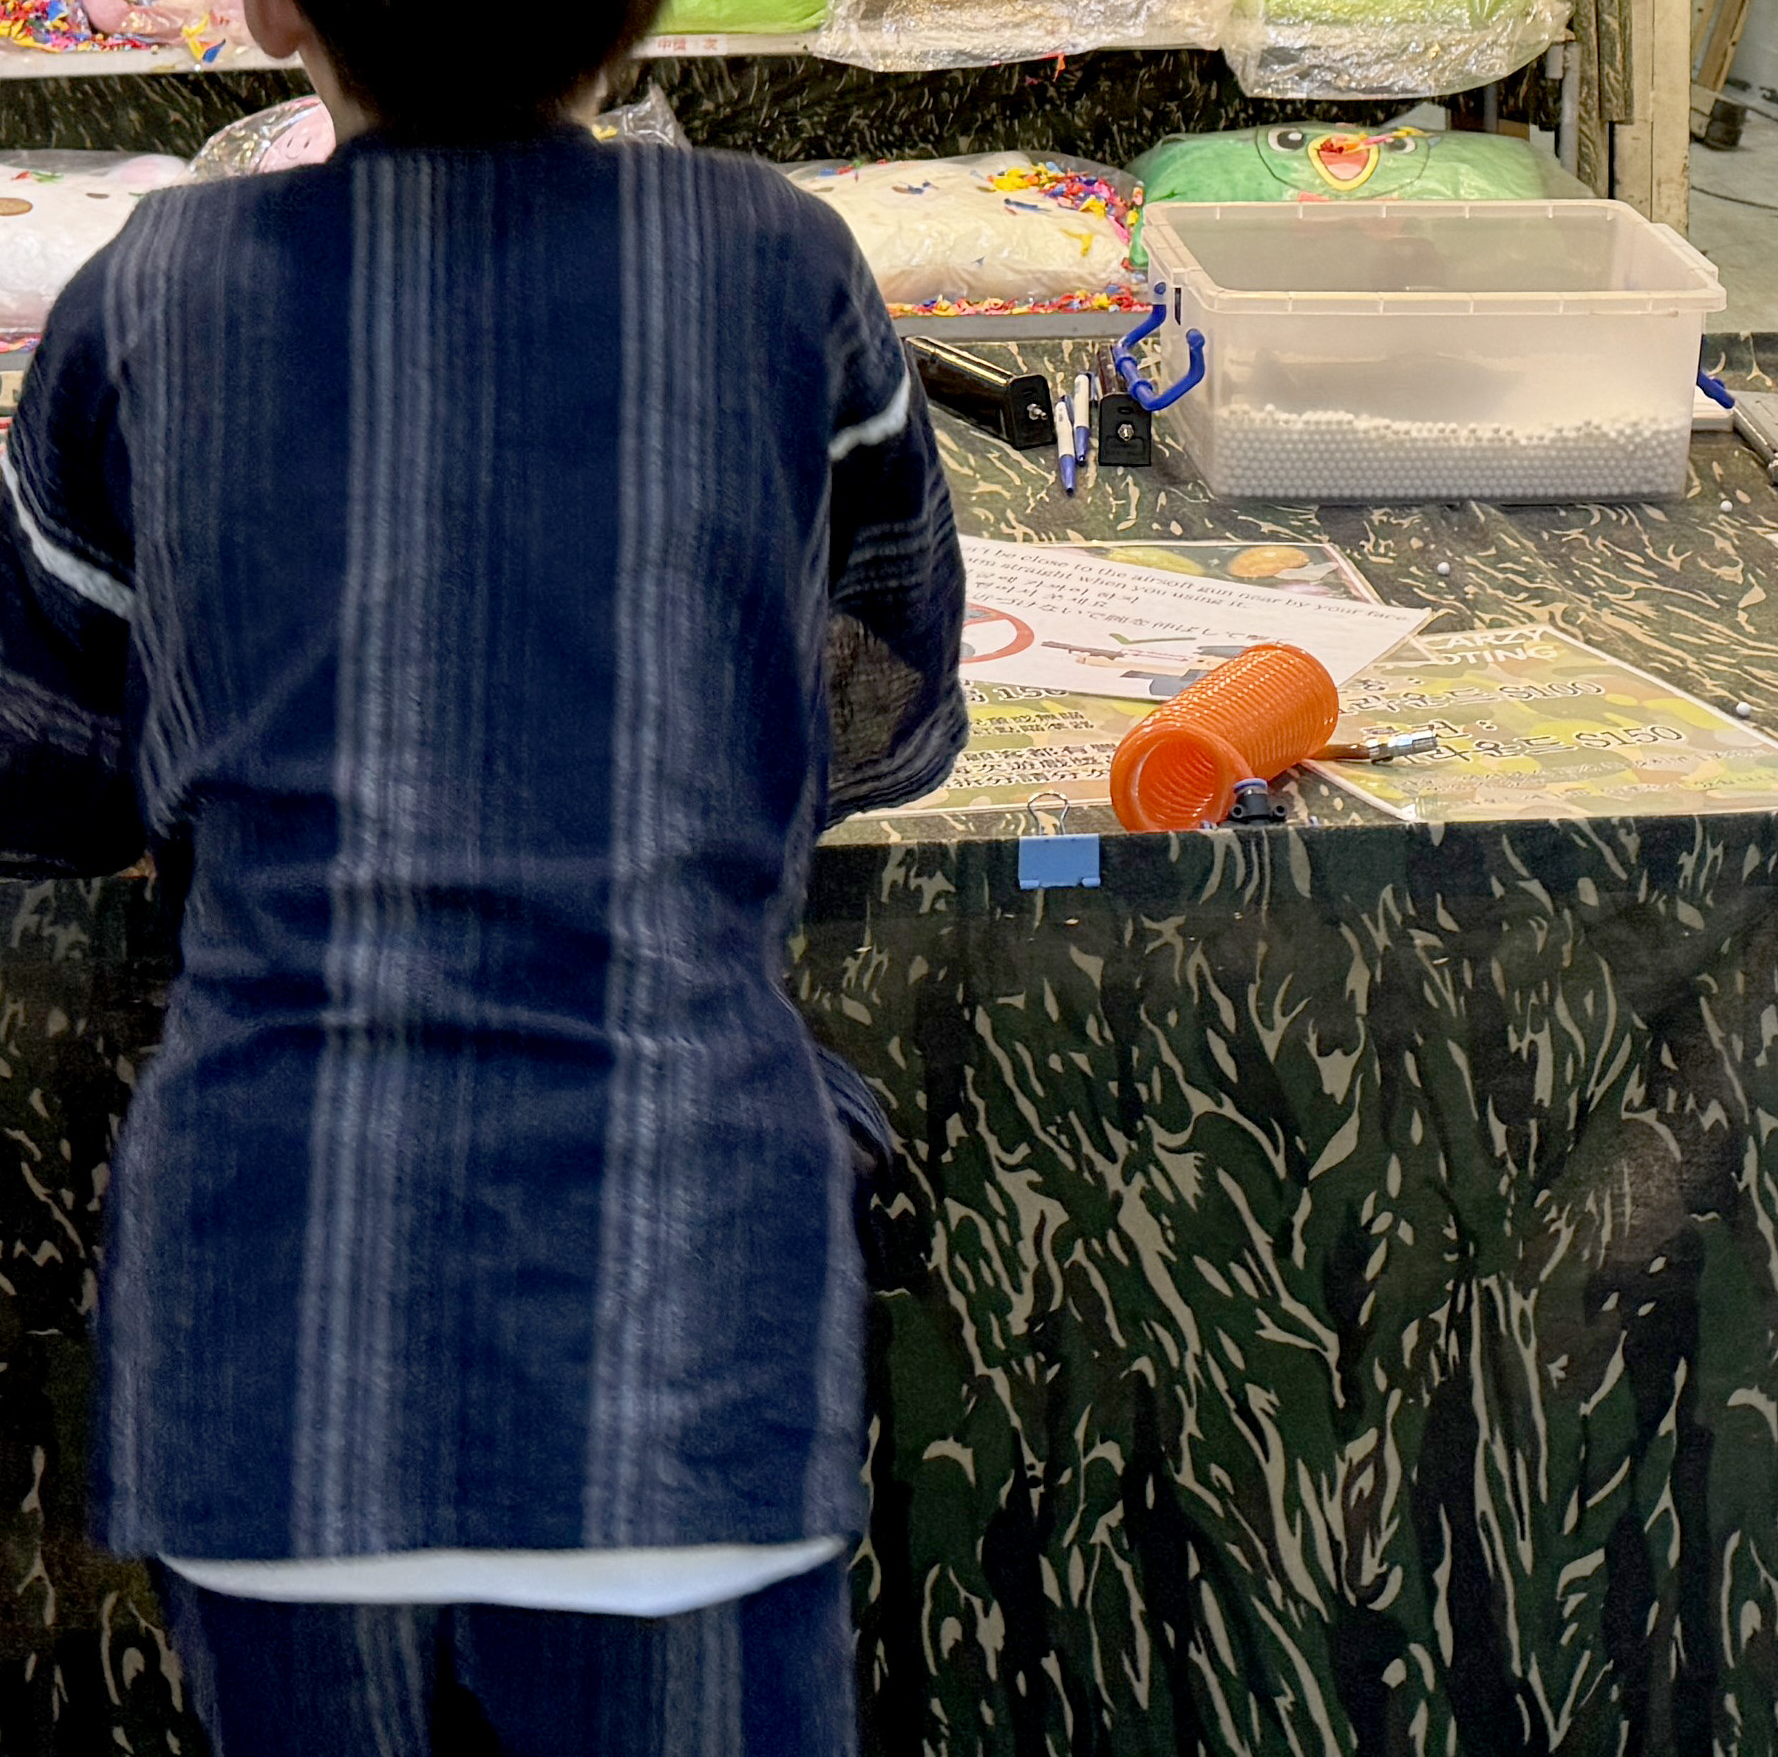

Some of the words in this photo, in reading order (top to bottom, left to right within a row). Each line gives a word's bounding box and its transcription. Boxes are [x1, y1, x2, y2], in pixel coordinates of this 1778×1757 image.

[1000, 563, 1073, 582] straight
[1079, 575, 1127, 590] when
[1130, 584, 1168, 598] you
[1020, 552, 1069, 568] close
[1074, 562, 1094, 573] to
[1098, 566, 1129, 579] the
[1130, 573, 1195, 590] airsoft
[1238, 592, 1282, 604] near
